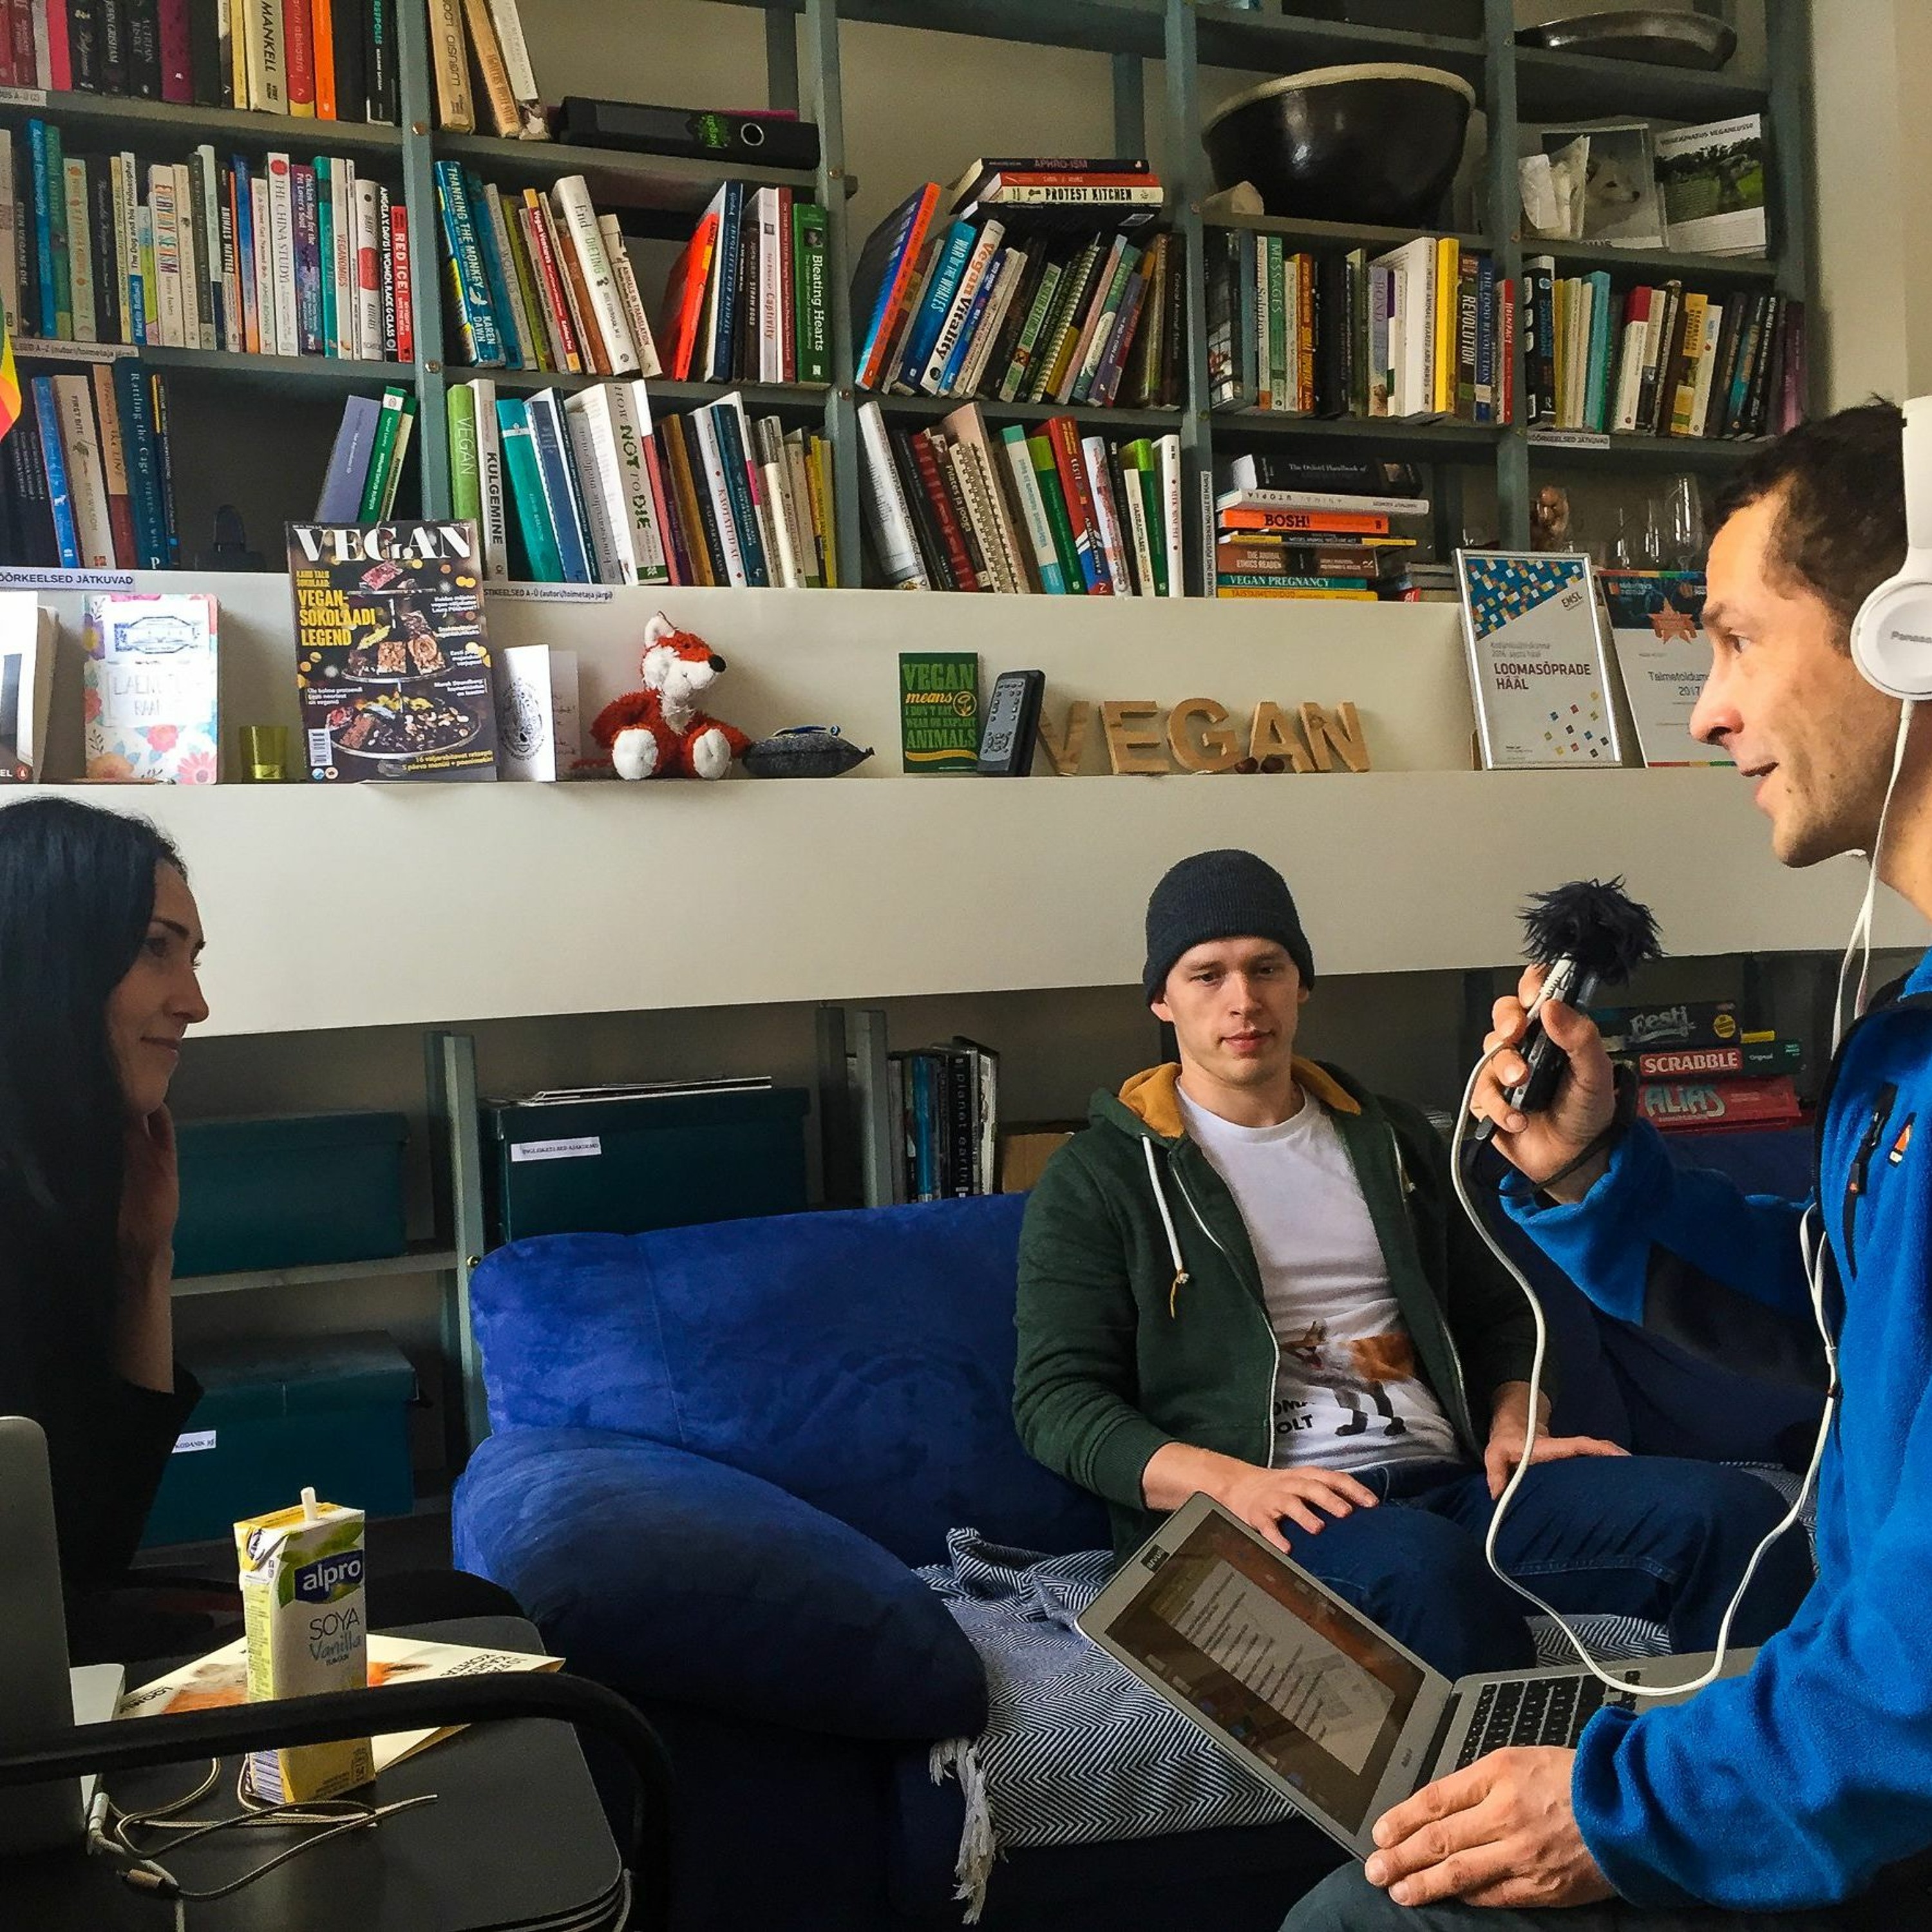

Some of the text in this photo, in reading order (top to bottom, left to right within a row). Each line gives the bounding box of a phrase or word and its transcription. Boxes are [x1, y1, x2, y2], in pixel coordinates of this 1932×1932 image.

[261, 0, 276, 71] MANKELL
[705, 115, 719, 145] vegan
[123, 160, 135, 207] Philosopher
[296, 172, 305, 184] Pet
[305, 173, 313, 201] Chicken
[1045, 187, 1132, 201] PROTEST KITCHEN
[126, 208, 135, 220] his
[379, 186, 389, 218] ANGELA
[272, 179, 291, 281] THE CHINA STUDY
[298, 212, 307, 227] Soul
[446, 166, 484, 289] THANKING THE MONKEY
[17, 229, 28, 267] VEGANS
[129, 242, 139, 253] Dog
[220, 206, 234, 272] ANIMALS MATTER
[381, 226, 390, 247] DAVIS
[532, 209, 552, 263] Vegan Ventures
[574, 203, 607, 275] End DIETING
[950, 237, 969, 258] WAR
[130, 258, 138, 268] The
[335, 233, 347, 287] VEGANOMICS
[394, 232, 408, 289] RED ICE
[943, 265, 958, 279] THE
[960, 240, 994, 298] Vegan
[19, 269, 28, 287] DIE
[1271, 243, 1282, 313] MESSAGES
[384, 285, 393, 307] RACE
[621, 265, 651, 346] ANIMALS IN TRANSLATION
[810, 254, 825, 351] Bleating Hearts
[930, 277, 954, 313] WHALES
[261, 305, 270, 334] BOWEN
[386, 313, 395, 337] CLASS
[472, 315, 487, 342] DAWN
[763, 292, 775, 339] Captivity
[933, 293, 972, 362] Vitality
[1256, 287, 1267, 339] Solution
[1481, 270, 1492, 383] THE FOOD REVOLUTION
[481, 315, 497, 345] KAREN
[1460, 294, 1479, 366] REVOLUTION
[70, 394, 84, 435] FIRST BITE
[128, 372, 151, 475] Rattling the Cage
[108, 429, 124, 477] the LINE
[456, 416, 477, 476] VEGAN
[618, 422, 641, 471] NOT
[630, 493, 652, 531] DIE
[1290, 463, 1302, 471] The
[484, 451, 504, 545] KULGEMINE
[944, 464, 972, 533] Pilates ja jooga
[1247, 492, 1293, 502] UTOPIA
[1264, 514, 1310, 528] BOSH!
[293, 526, 472, 562] VEGAN
[151, 556, 160, 569] P
[1229, 574, 1330, 587] VEGAN PREGNANCY
[298, 589, 349, 607] VEGAN-
[299, 606, 376, 627] ŠOKOLAADI
[301, 629, 352, 647] LEGEND
[902, 663, 975, 691] VEGAN
[1493, 661, 1592, 676] LOOMASÕPRADE
[1496, 676, 1530, 690] HÄÄL
[905, 691, 953, 704] means
[1678, 686, 1700, 696] 2017
[906, 728, 977, 749] ANIMALS
[1037, 697, 1372, 774] VEGAN
[1643, 1051, 1739, 1074] SCRABBLE
[1645, 1084, 1725, 1118] ALIAS
[956, 1074, 967, 1182] planet earth
[301, 1558, 362, 1592] alpro
[309, 1607, 361, 1642] SOYA
[310, 1631, 363, 1663] Vanilla
